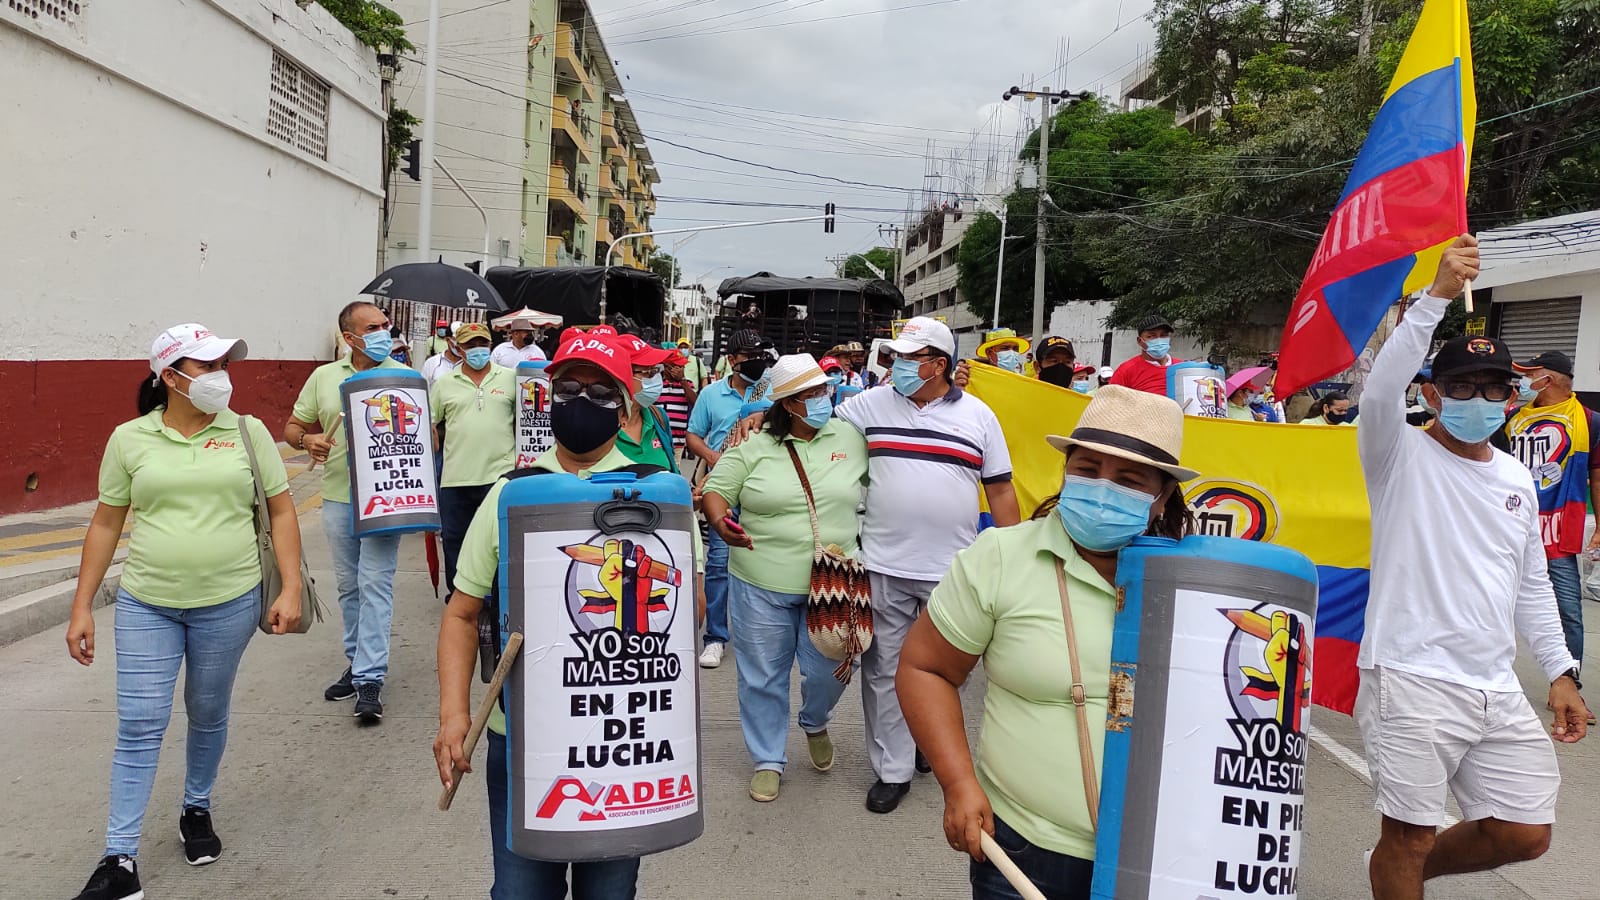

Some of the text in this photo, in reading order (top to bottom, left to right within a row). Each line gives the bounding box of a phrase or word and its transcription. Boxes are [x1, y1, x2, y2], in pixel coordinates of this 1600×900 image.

[567, 338, 615, 358] ADEA
[519, 419, 552, 427] MAESTR
[522, 409, 536, 419] YO
[375, 433, 416, 447] YO SOY
[521, 429, 533, 437] EN
[529, 437, 543, 445] DE
[369, 444, 424, 456] MAESTRO
[373, 458, 421, 470] EN PIE
[389, 469, 409, 480] DE
[374, 479, 424, 492] LUCHA
[577, 630, 666, 662] YO SOY
[567, 656, 679, 683] MAESTRO
[570, 689, 672, 717] EN PIE
[603, 717, 645, 741] DE
[1235, 723, 1281, 758] YO
[568, 740, 674, 768] LUCHA
[1220, 753, 1304, 790] MAESTR
[604, 774, 693, 806] ADEA
[1222, 796, 1269, 829] EN
[1257, 833, 1290, 862] DE
